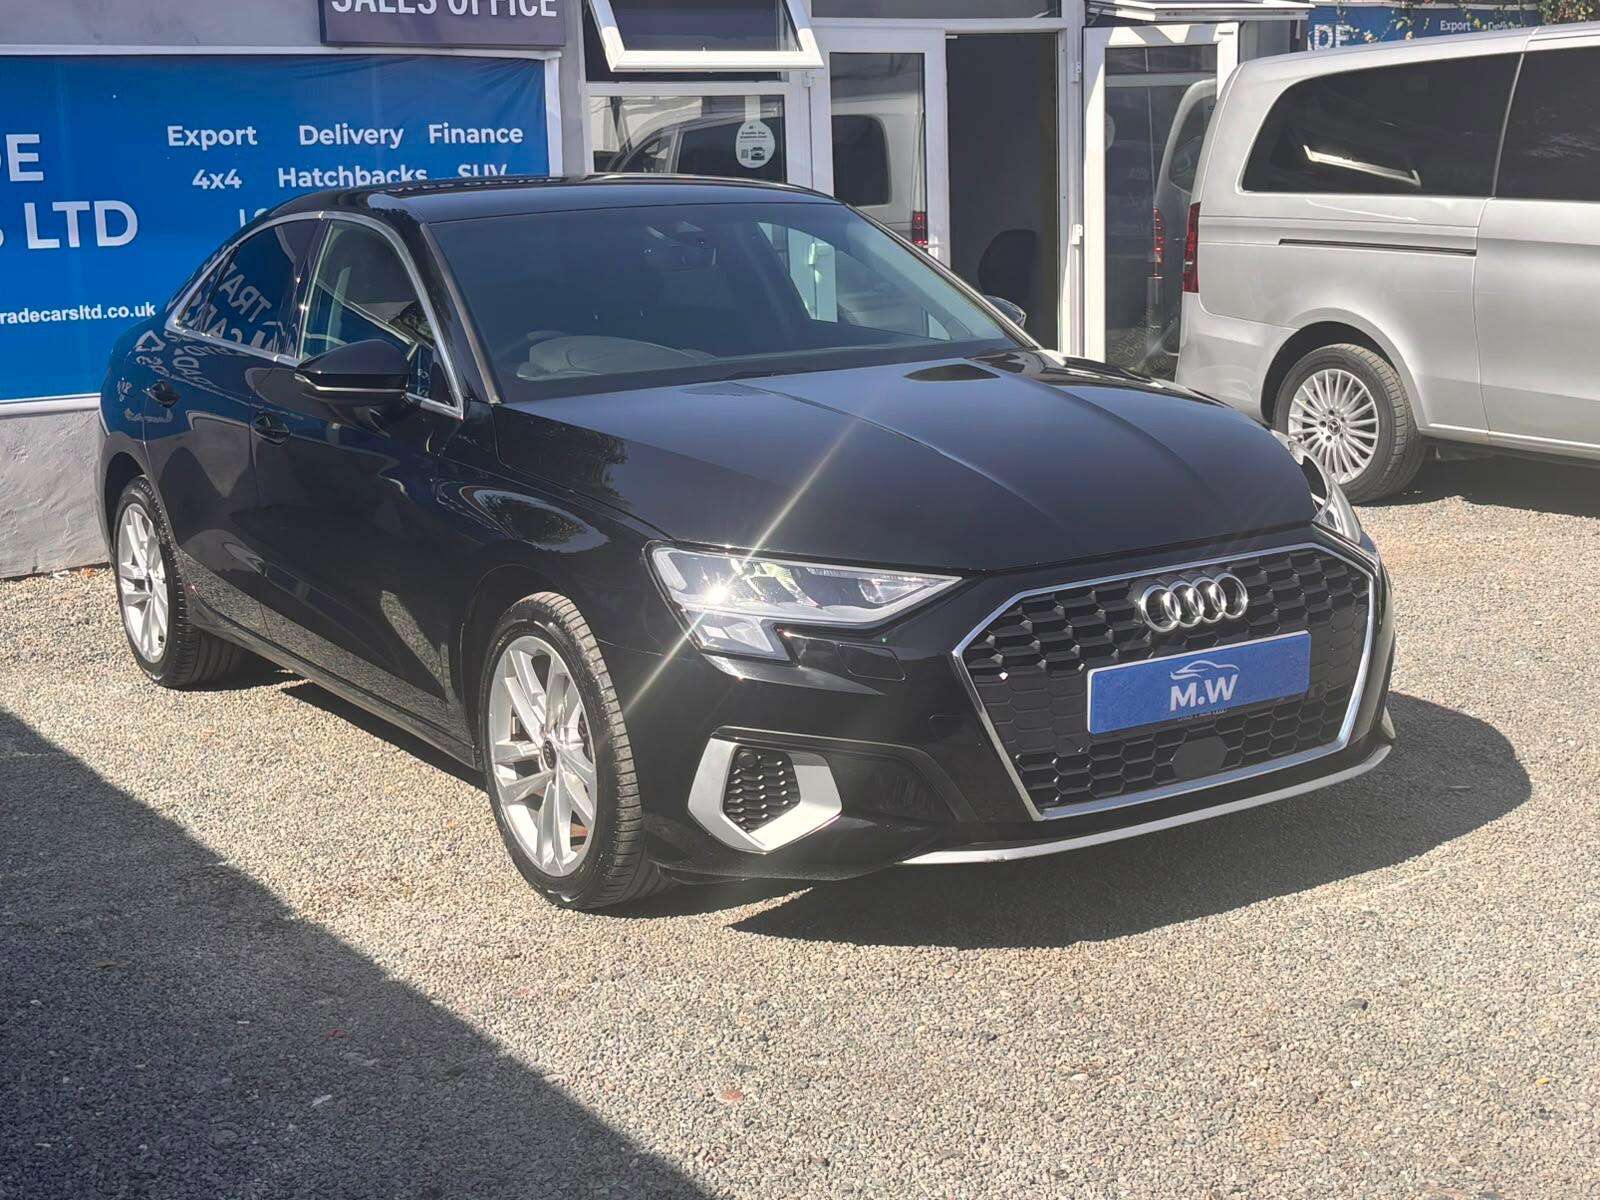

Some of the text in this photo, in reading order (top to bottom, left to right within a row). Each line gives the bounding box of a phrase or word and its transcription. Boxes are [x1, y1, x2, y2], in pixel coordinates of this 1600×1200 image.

[1440, 20, 1471, 33] Export
[167, 122, 523, 151] Export Delivery Finance
[0, 133, 44, 182] E
[192, 163, 508, 190] 4x4 Hatchbacks SUV
[24, 199, 139, 249] LTD
[0, 301, 156, 325] radecarsltd.co.uk
[1169, 673, 1238, 712] M.W
